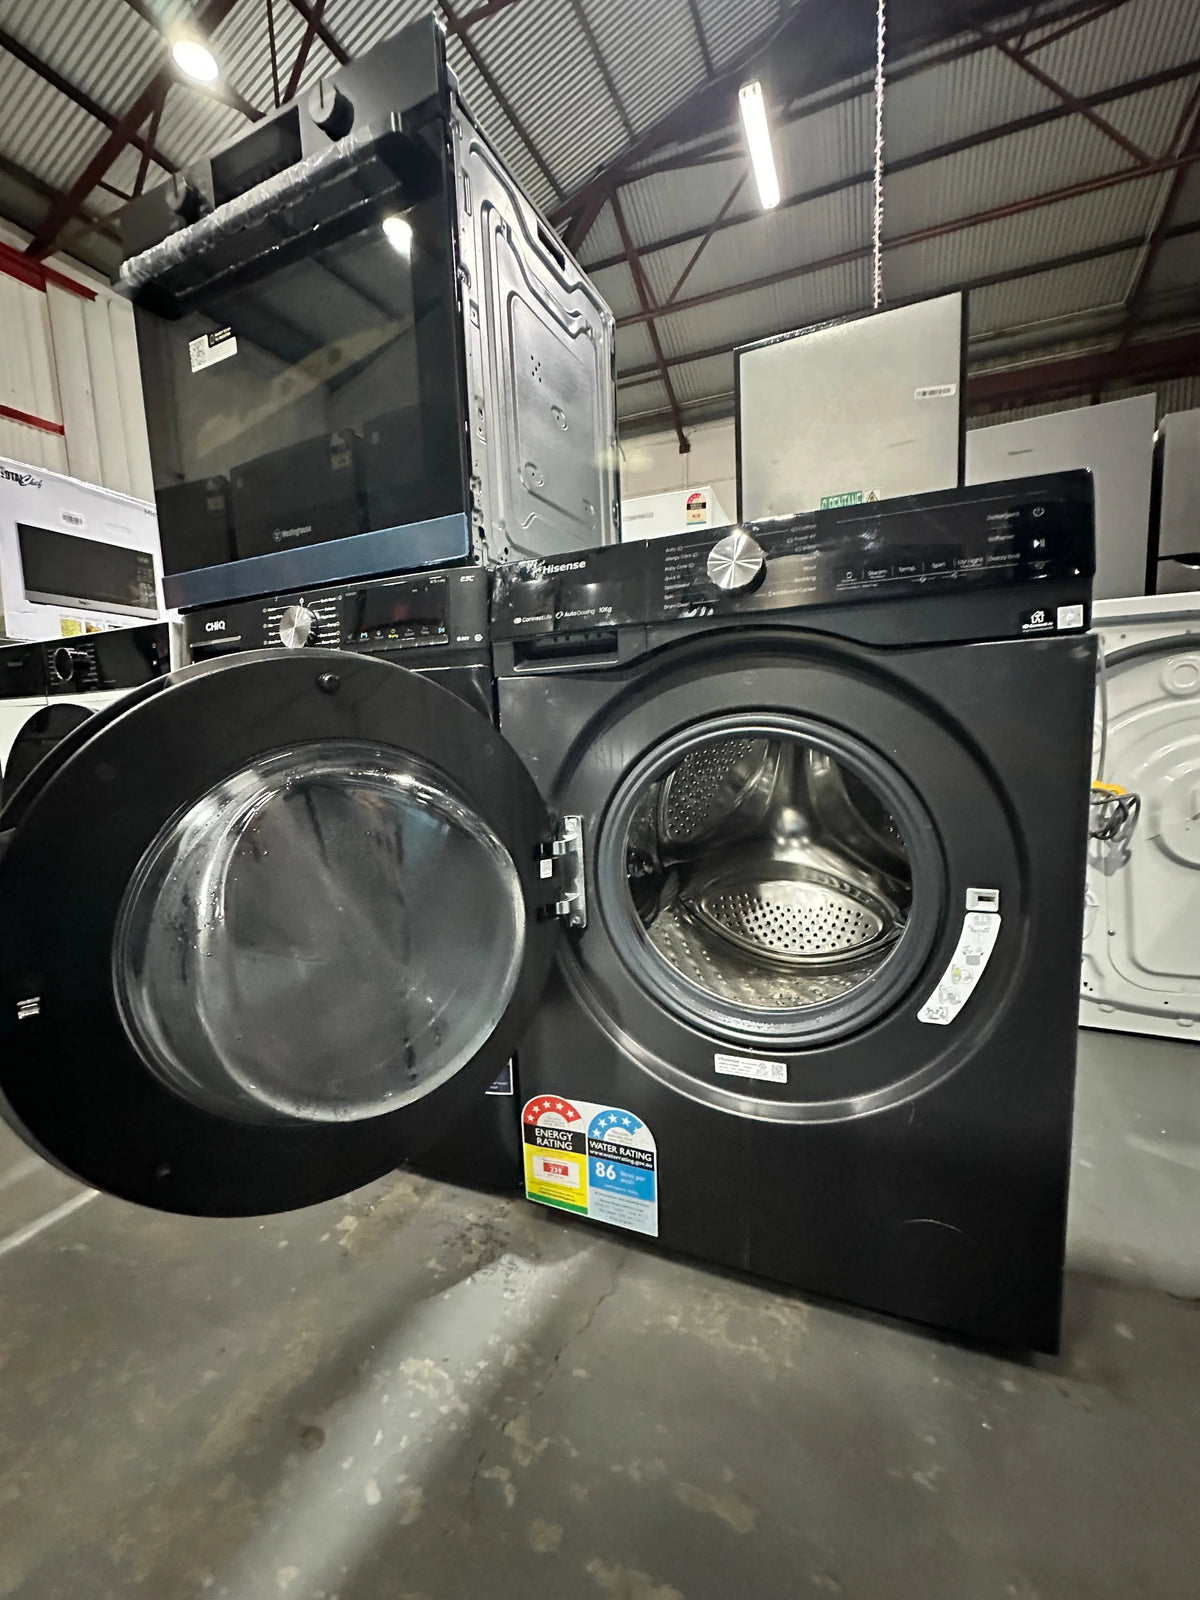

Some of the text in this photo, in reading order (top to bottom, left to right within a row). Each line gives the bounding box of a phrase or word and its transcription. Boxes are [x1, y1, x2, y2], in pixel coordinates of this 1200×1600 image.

[542, 560, 586, 574] Hisense
[205, 620, 226, 632] CHiQ
[535, 1127, 574, 1142] ENERGY
[536, 1138, 573, 1151] RATING
[589, 1140, 618, 1154] WATER
[619, 1145, 652, 1162] RATING
[595, 1161, 616, 1180] 86
